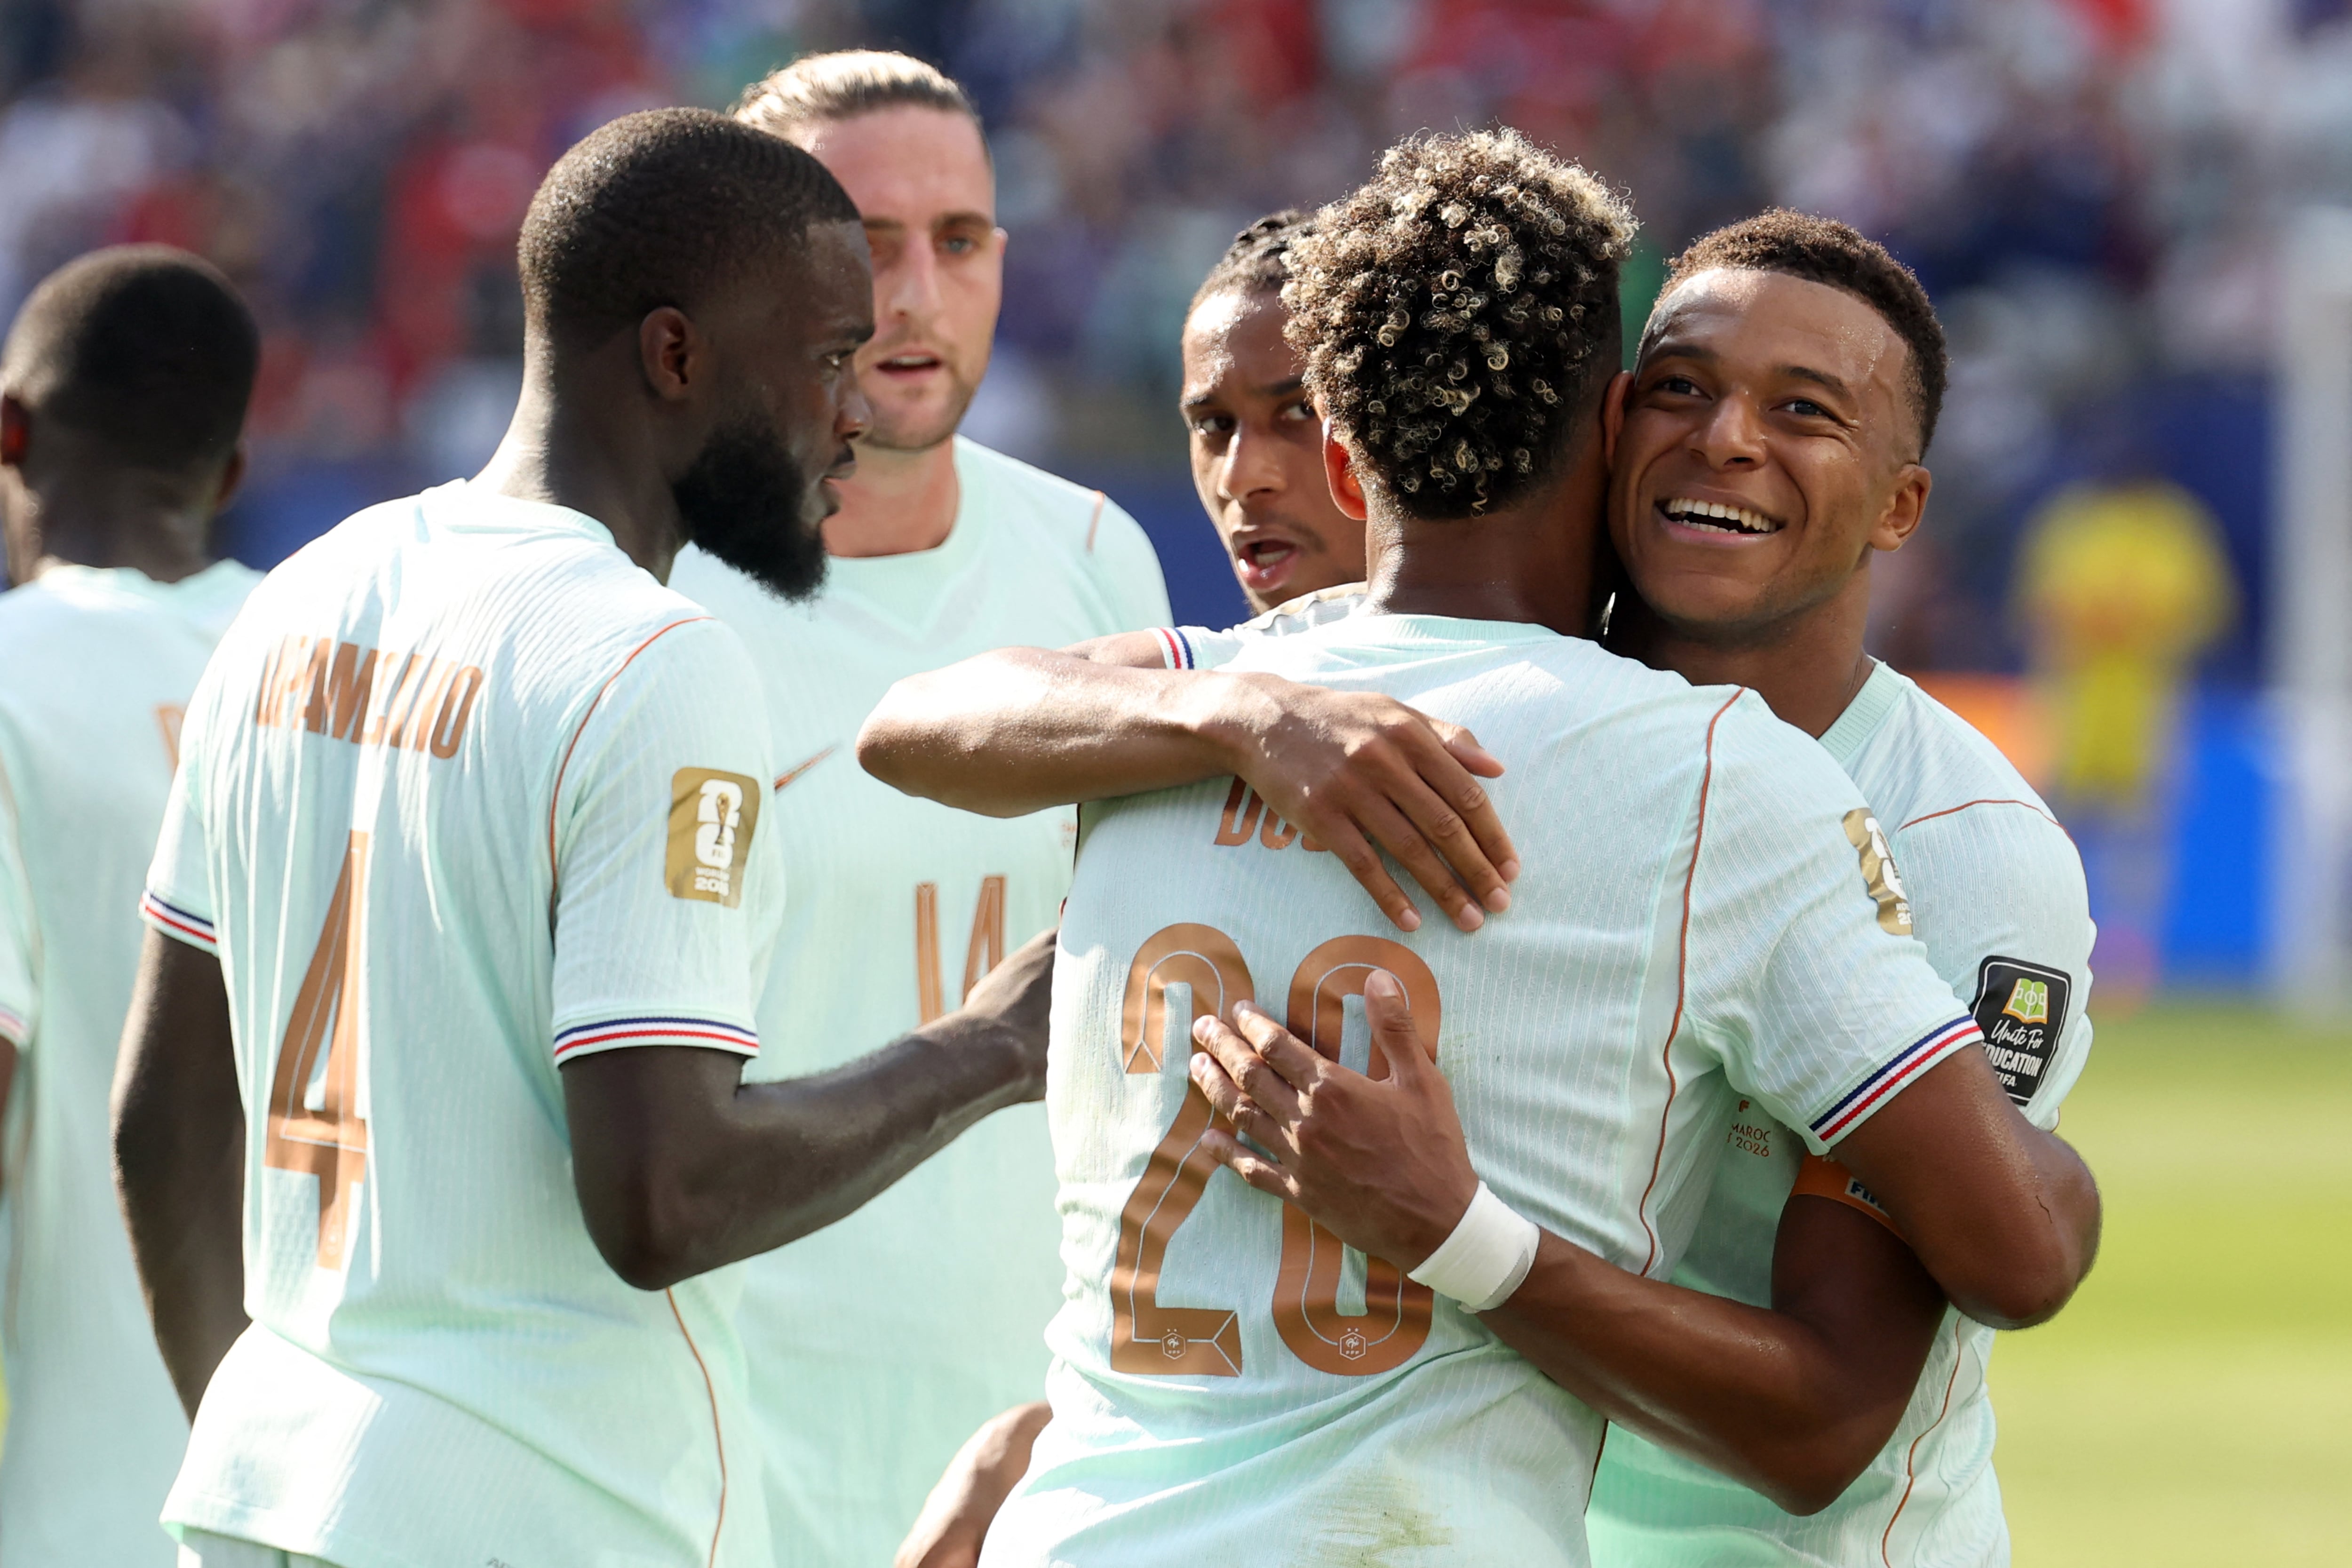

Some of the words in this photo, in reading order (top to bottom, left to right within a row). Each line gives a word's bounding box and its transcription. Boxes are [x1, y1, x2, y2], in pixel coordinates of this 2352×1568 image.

[264, 829, 368, 1272] 4
[1110, 922, 1441, 1377] 20
[1980, 1041, 2043, 1077] DUCATION
[1991, 1019, 2027, 1046] Unite
[2028, 1029, 2044, 1051] For
